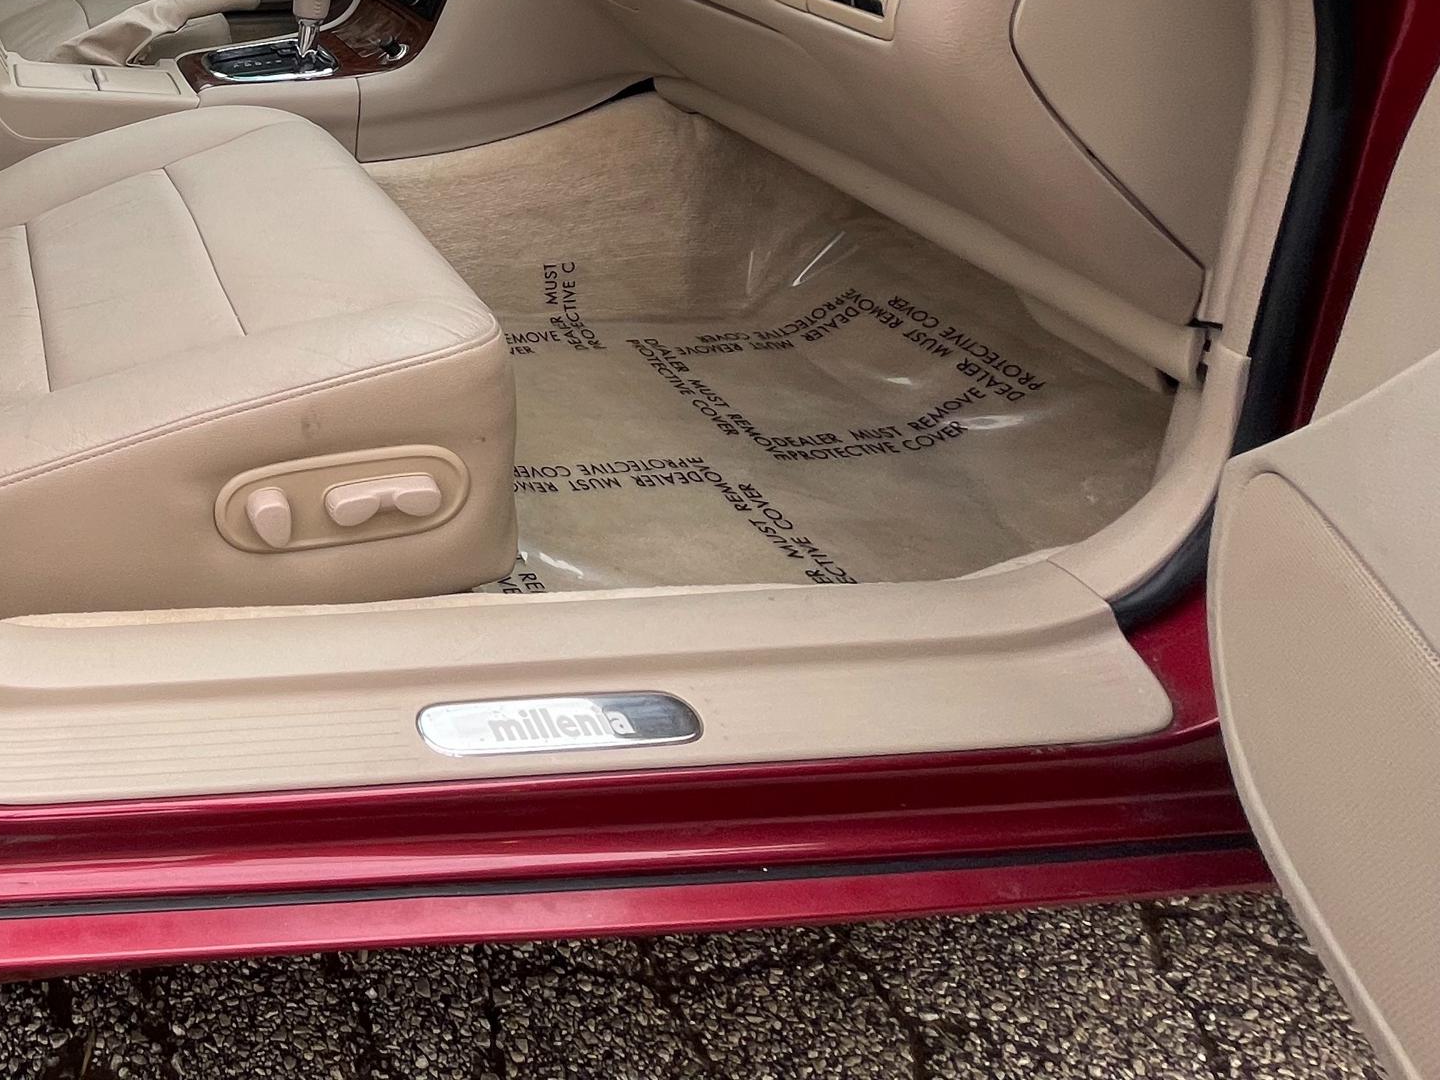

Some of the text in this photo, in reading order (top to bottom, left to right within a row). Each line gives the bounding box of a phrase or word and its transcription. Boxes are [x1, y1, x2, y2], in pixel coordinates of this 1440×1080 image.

[543, 264, 559, 305] MUST
[505, 330, 561, 345] EMOVE
[753, 295, 846, 341] PROTECTIVE
[804, 306, 860, 343] DEALER
[679, 343, 744, 356] REMOVE
[841, 288, 1026, 402] DEALER MUST REMOVE
[887, 295, 1047, 391] PROTECTIVE COVER
[625, 339, 740, 437] PROTECTIVE COVER
[643, 338, 791, 461] DEALER MUST REMOVE
[771, 386, 987, 448] DEALER MUST REMOVE
[788, 420, 969, 462] PROTECTIVE COVER
[568, 476, 623, 493] MUST
[576, 457, 689, 476] PROTECTIVE
[631, 471, 705, 488] DEALER
[686, 456, 805, 560] MUST REMOVE
[738, 482, 858, 585] ECTIVE COVER
